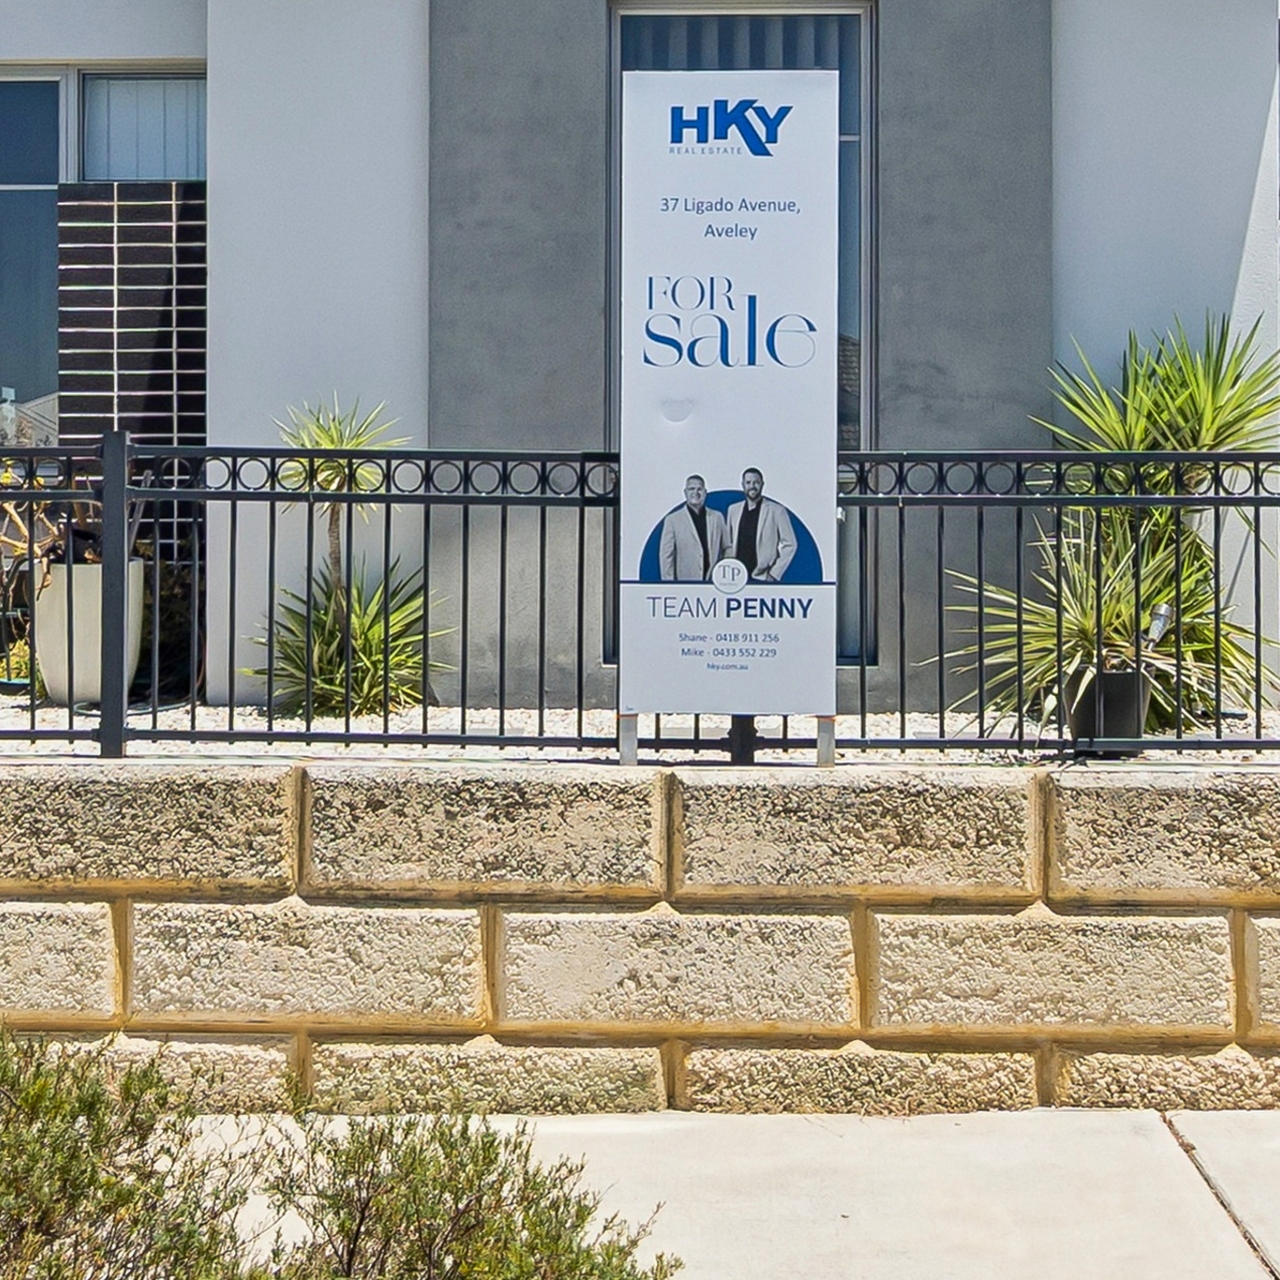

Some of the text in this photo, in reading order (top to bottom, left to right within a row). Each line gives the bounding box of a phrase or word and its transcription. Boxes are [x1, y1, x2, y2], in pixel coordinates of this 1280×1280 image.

[670, 98, 793, 157] HKY
[669, 146, 742, 155] REAL ESTATE
[660, 197, 801, 215] 37 Ligado Avenue,
[704, 223, 758, 240] Aveley
[646, 275, 735, 311] FOR
[643, 294, 818, 368] sale
[646, 596, 814, 619] TEAM PENNY
[679, 633, 708, 642] Shane
[715, 633, 739, 642] 0418
[741, 633, 759, 642] 911
[762, 633, 780, 642] 256
[681, 648, 705, 656] Mike
[713, 648, 736, 657] 0433
[739, 648, 756, 657] 552
[759, 648, 777, 657] 229
